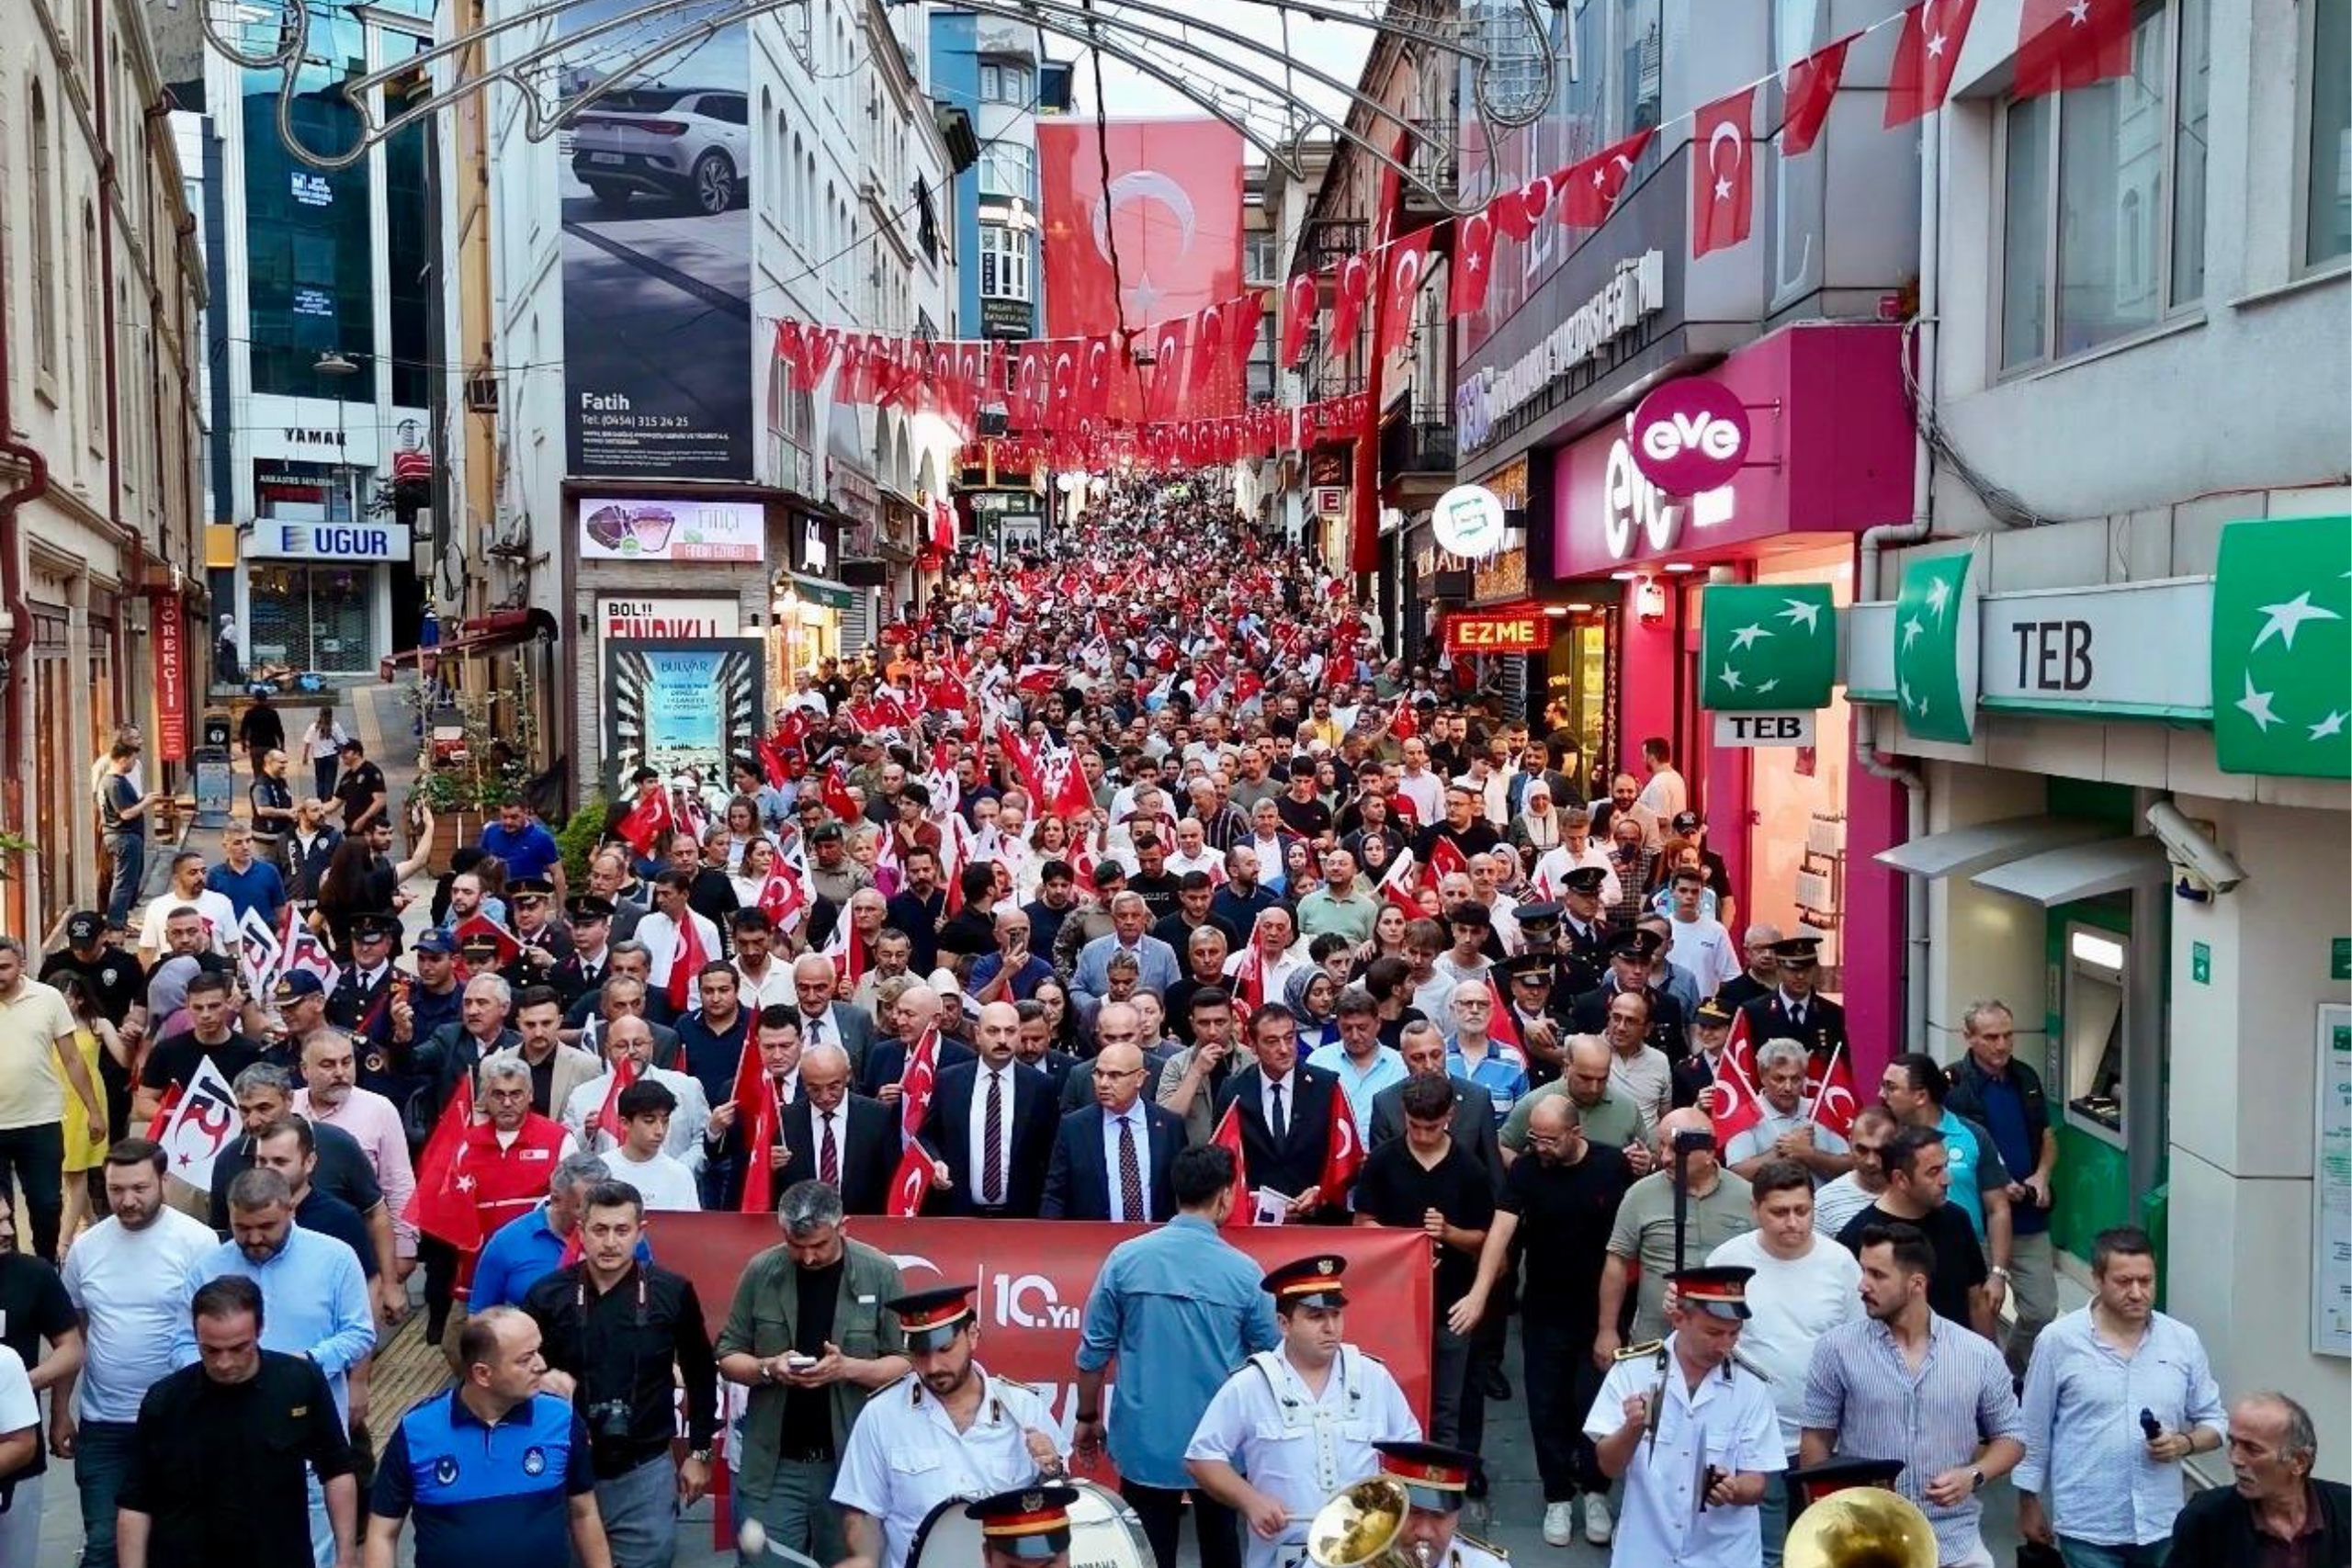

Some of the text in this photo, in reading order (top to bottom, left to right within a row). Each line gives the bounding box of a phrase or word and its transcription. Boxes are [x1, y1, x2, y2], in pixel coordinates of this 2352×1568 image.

[581, 392, 630, 411] Fatih
[638, 416, 658, 427] 315
[661, 417, 673, 427] 24
[676, 417, 689, 427] 25
[1643, 411, 1741, 460] eve
[1324, 492, 1339, 510] E
[314, 525, 389, 556] UĞUR
[608, 603, 652, 616] BOL!!
[1459, 621, 1534, 644] EZME
[2012, 620, 2093, 691] TEB
[1729, 716, 1802, 739] TEB
